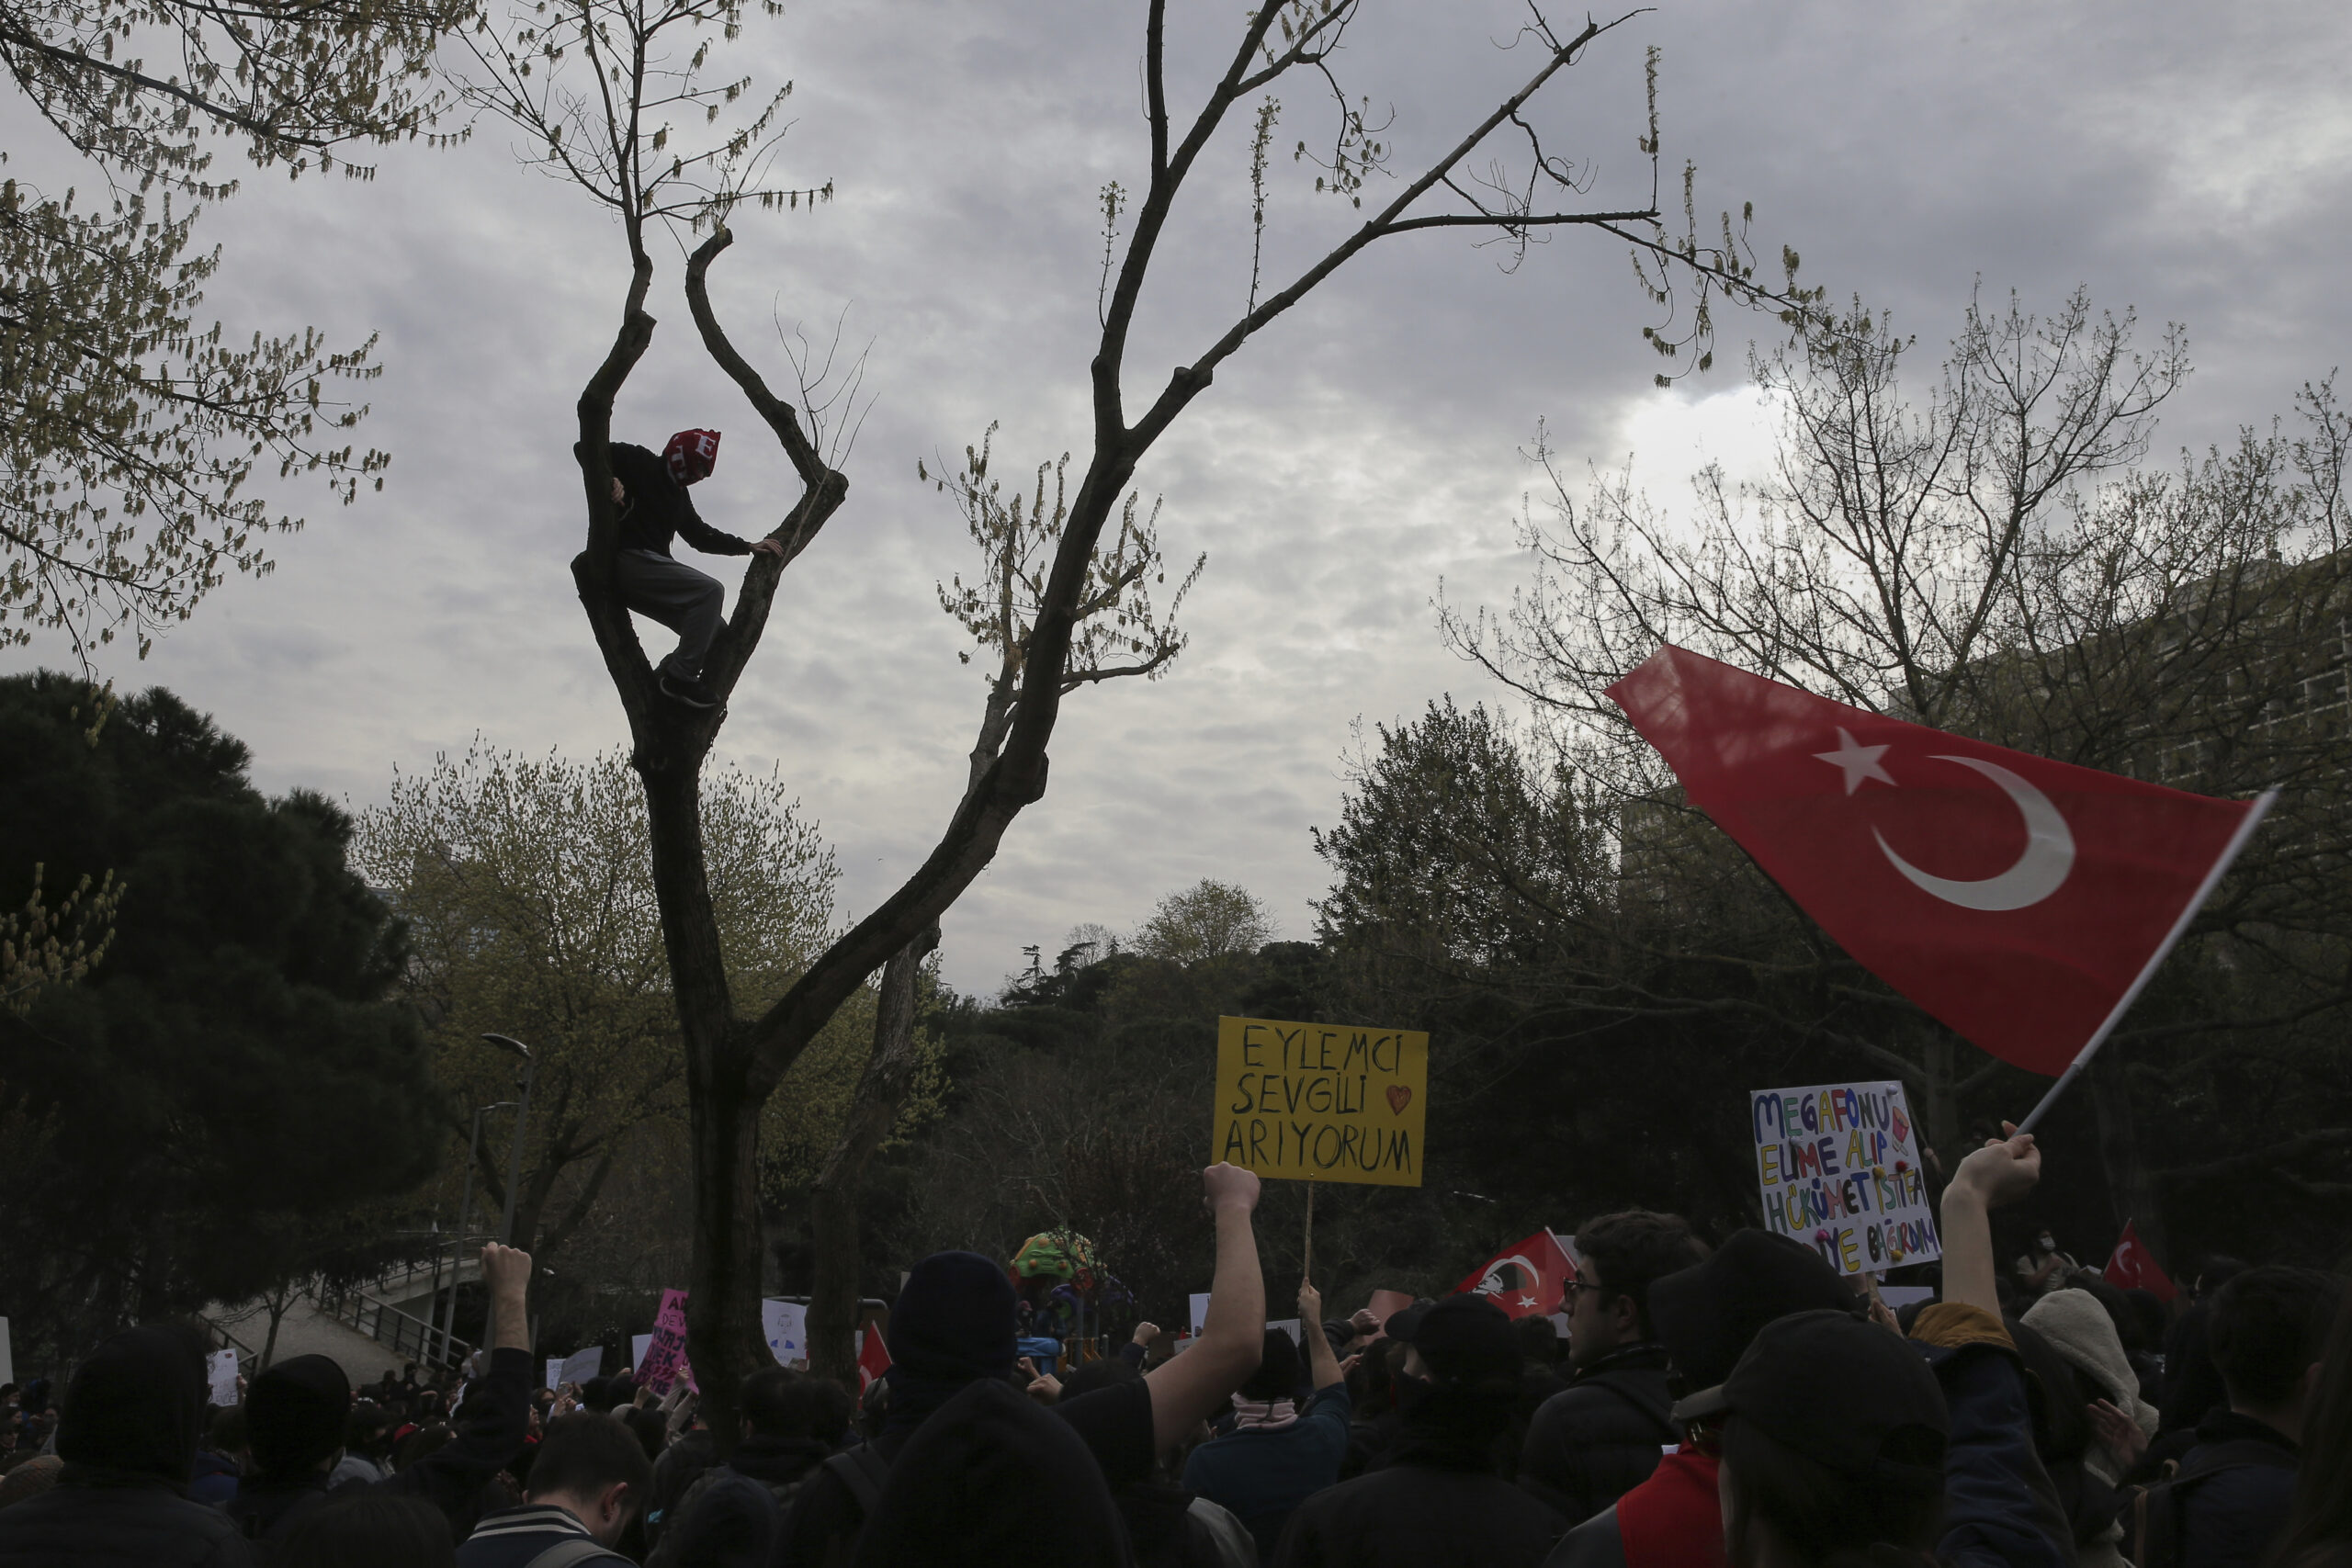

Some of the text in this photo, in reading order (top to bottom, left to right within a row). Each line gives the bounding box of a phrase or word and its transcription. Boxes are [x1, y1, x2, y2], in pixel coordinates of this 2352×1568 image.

[1231, 1072, 1367, 1114] SEVGİLİ
[1753, 1088, 1890, 1144] MEGAFONU
[1223, 1119, 1411, 1175] ARIYORUM
[1846, 1129, 1888, 1169] ALIP
[1766, 1171, 1871, 1235] HÜKÜMET
